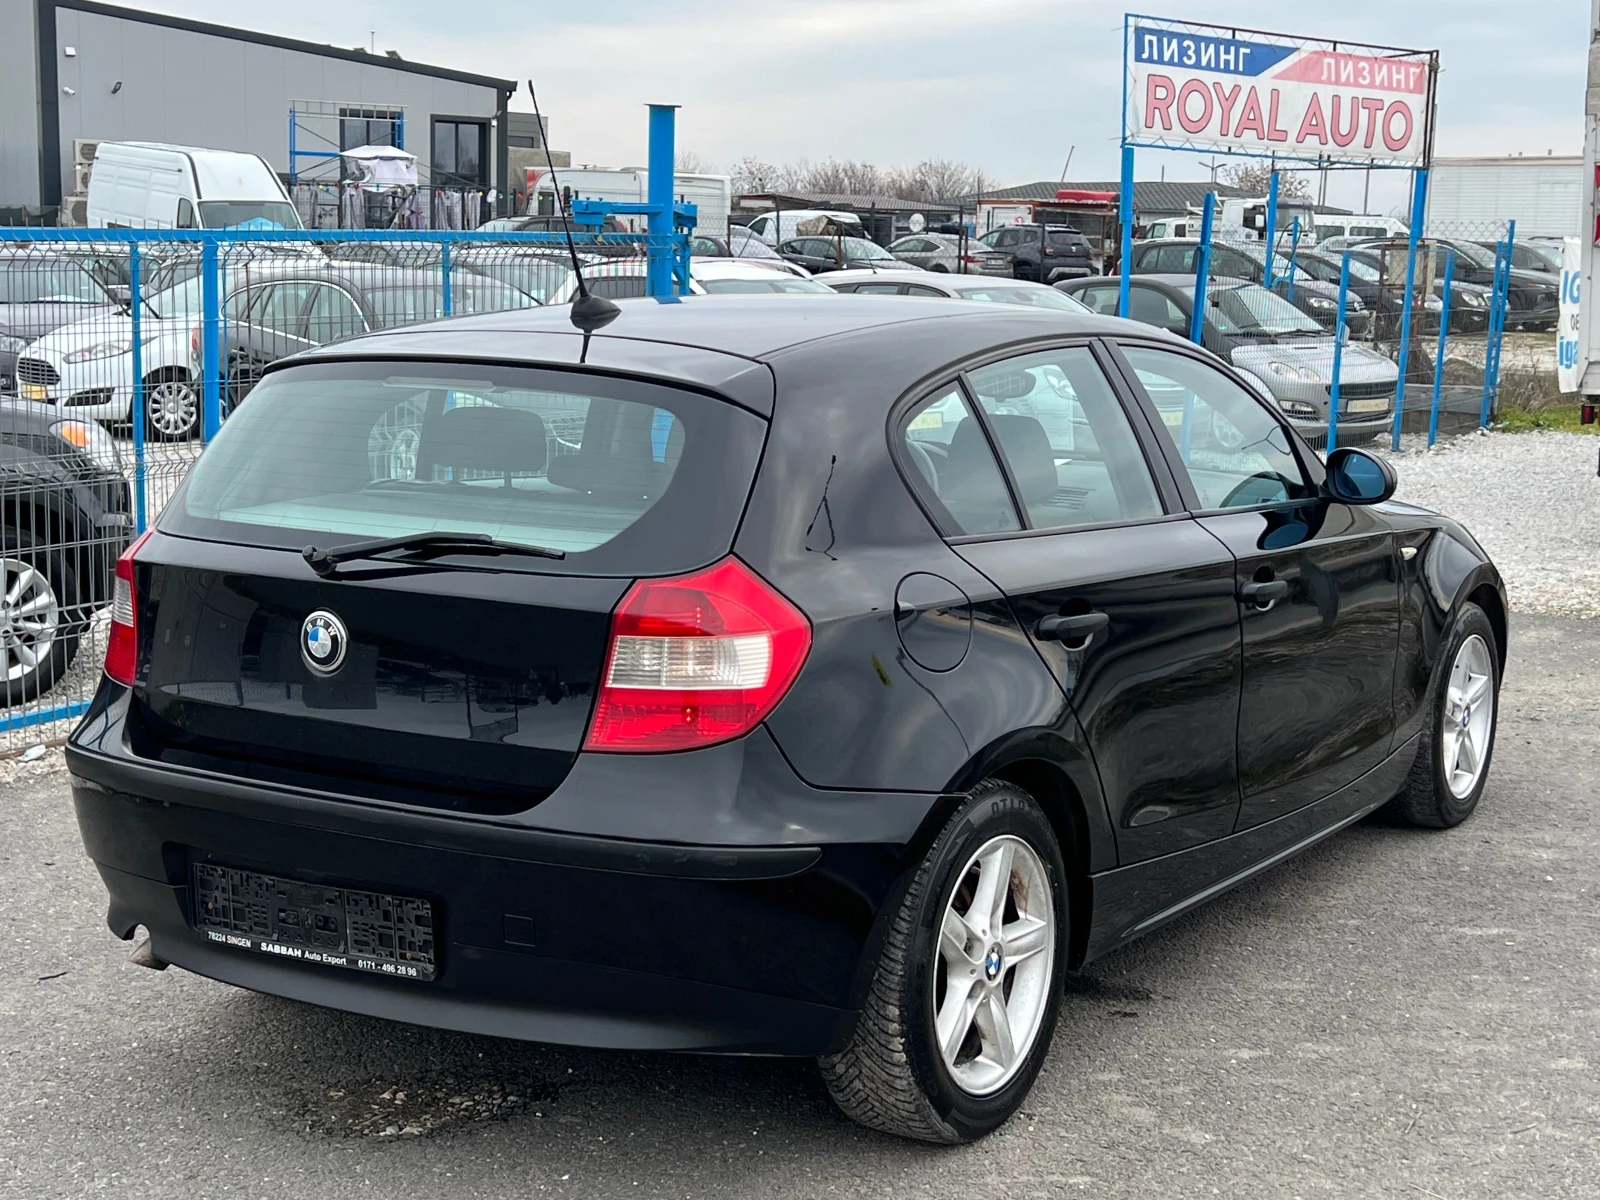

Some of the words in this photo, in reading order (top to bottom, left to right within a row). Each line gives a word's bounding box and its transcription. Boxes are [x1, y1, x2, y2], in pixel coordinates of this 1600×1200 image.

[1141, 34, 1251, 72] ЛИЗИНГ
[1320, 57, 1421, 90] ЛИЗИНГ
[1144, 73, 1288, 142] ROYAL
[1296, 92, 1413, 152] AUTO
[306, 618, 337, 636] BMW
[207, 931, 226, 943] 78224
[226, 935, 252, 948] SINGEN
[260, 942, 302, 957] SABBAH
[304, 950, 321, 961] Auto
[322, 953, 347, 965] Export
[357, 959, 375, 970] 0171
[382, 963, 396, 973] 496
[397, 965, 407, 975] 28
[407, 967, 417, 977] 96
